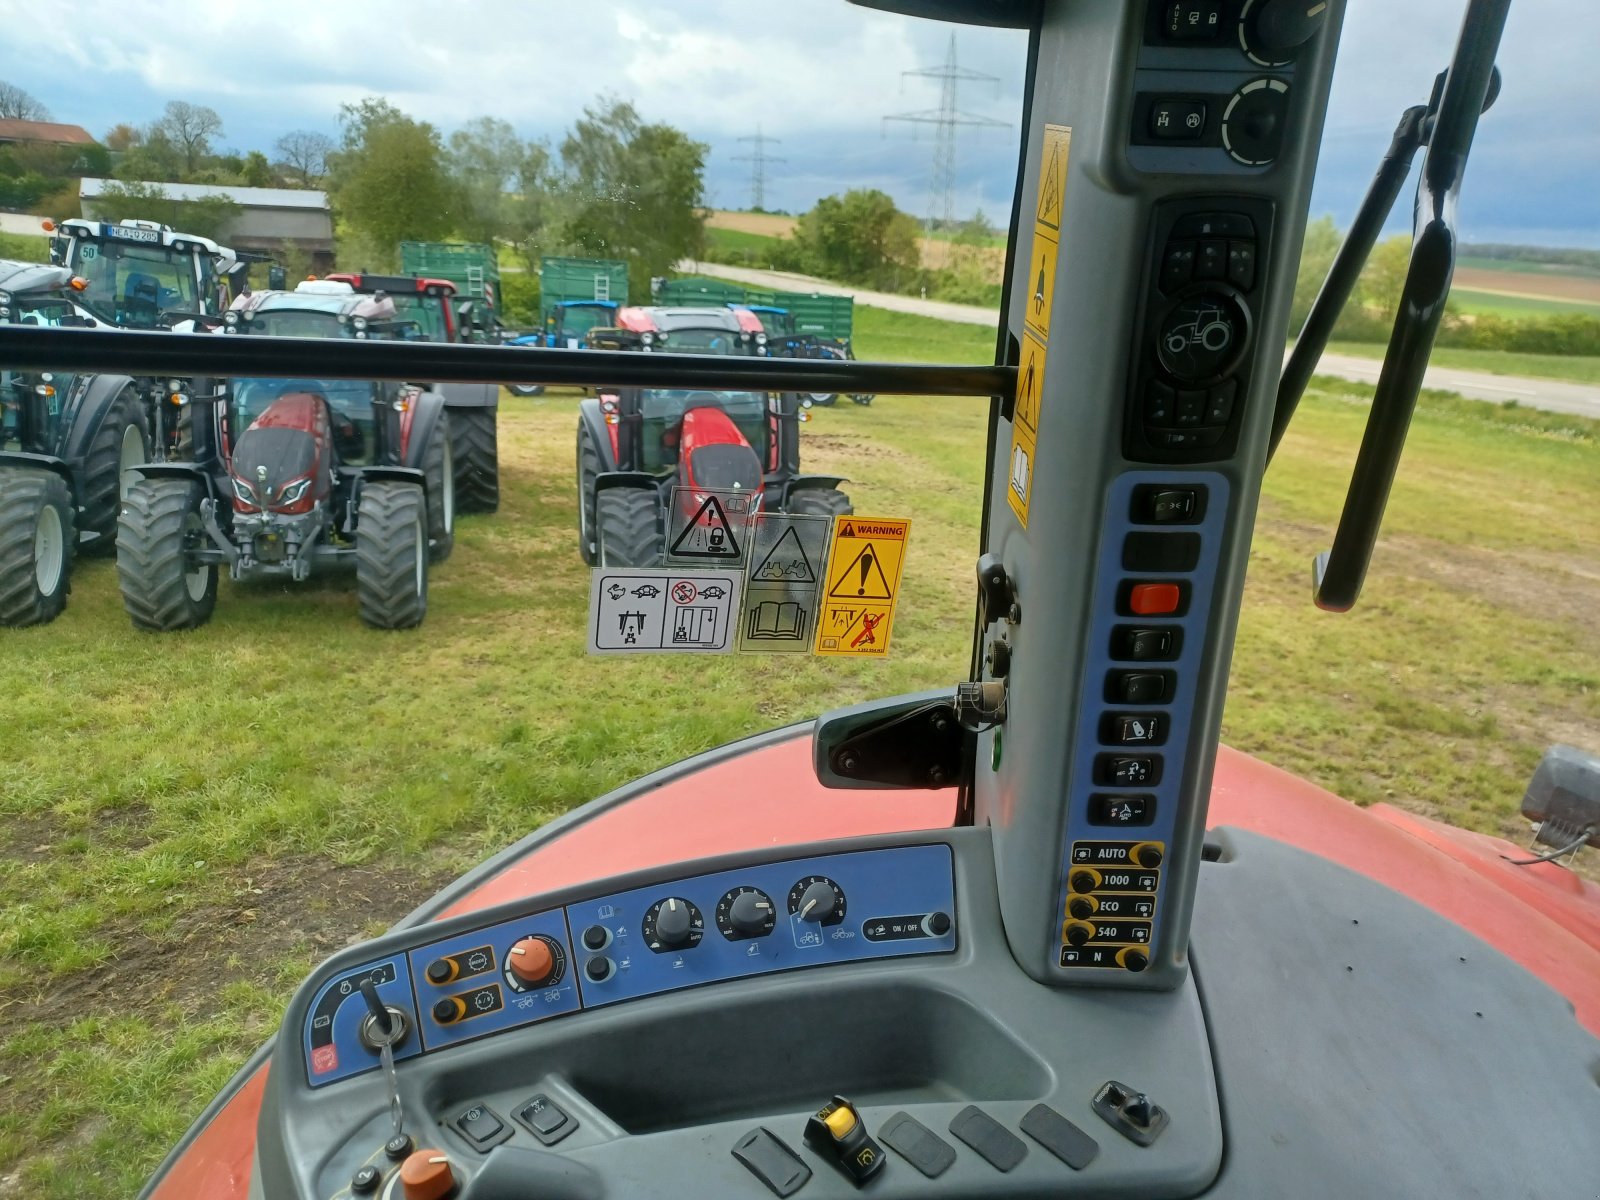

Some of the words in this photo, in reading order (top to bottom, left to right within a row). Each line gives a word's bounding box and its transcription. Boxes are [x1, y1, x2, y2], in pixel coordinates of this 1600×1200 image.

[1171, 3, 1180, 31] AUTO
[83, 247, 95, 259] 50
[857, 525, 903, 536] WARNING
[1098, 848, 1126, 859] AUTO
[1104, 875, 1130, 885] 1000
[1100, 901, 1119, 911] ECO
[1097, 927, 1117, 937] 540
[1094, 952, 1102, 962] N
[817, 1107, 831, 1120] ON
[389, 1137, 404, 1148] OFF
[358, 1170, 372, 1179] 2
